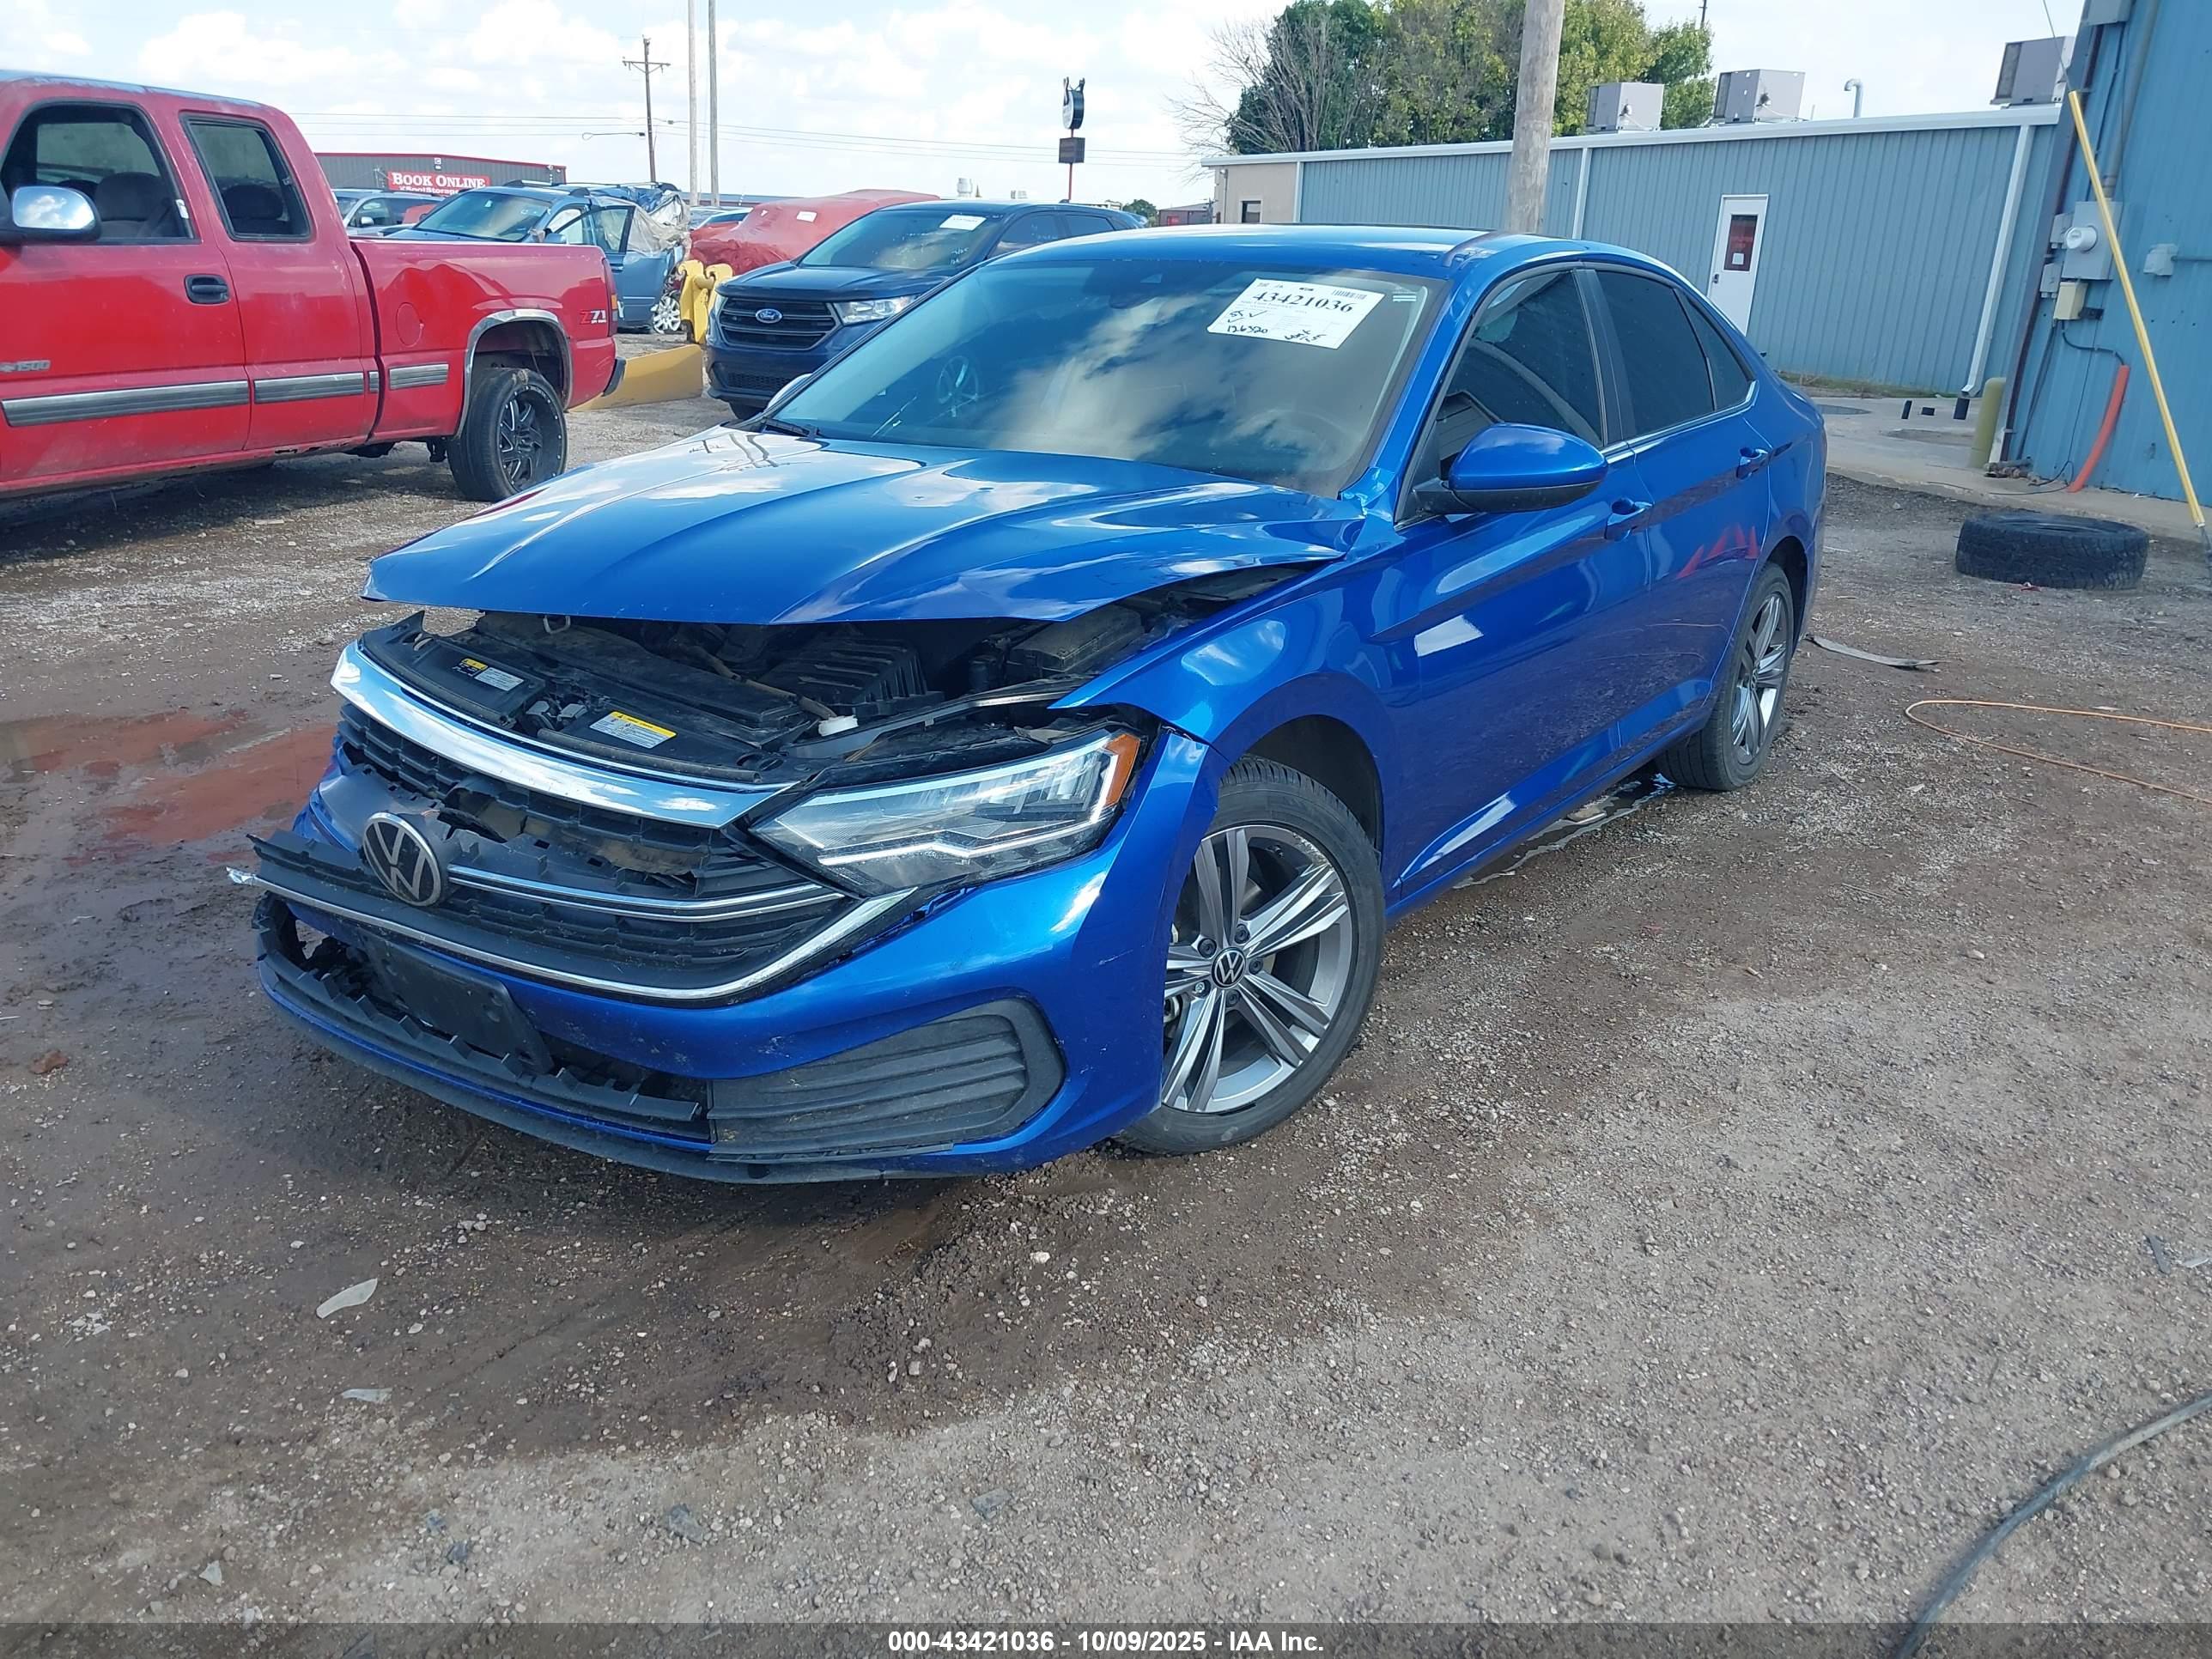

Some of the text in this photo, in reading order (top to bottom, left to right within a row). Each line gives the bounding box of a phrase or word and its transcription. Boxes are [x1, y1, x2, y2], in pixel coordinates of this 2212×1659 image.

[392, 172, 486, 188] BOOK ONLINE
[1253, 291, 1354, 313] 43421036
